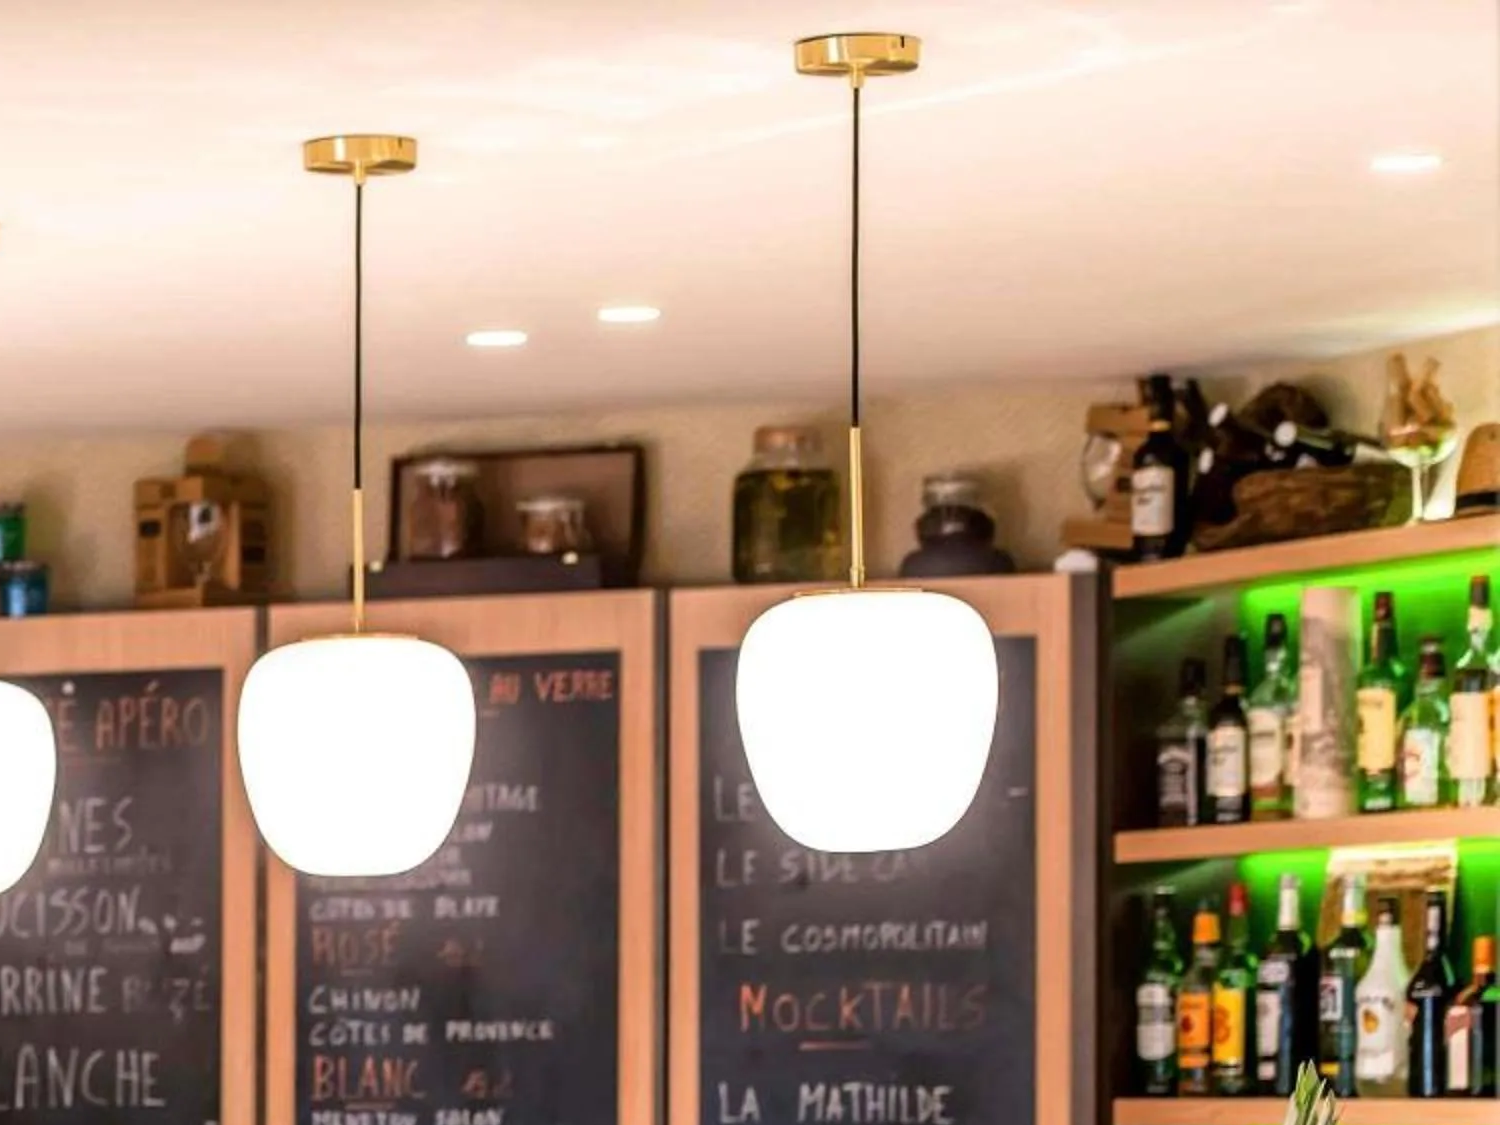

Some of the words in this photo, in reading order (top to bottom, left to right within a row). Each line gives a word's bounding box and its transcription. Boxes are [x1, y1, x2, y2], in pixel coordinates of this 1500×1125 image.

[533, 669, 613, 702] VERRE
[93, 679, 209, 751] APÉRO
[713, 774, 757, 823] LE
[715, 847, 759, 890] LE
[777, 846, 862, 886] SIDE
[311, 920, 400, 967] ROSÉ
[719, 916, 762, 956] LE
[779, 917, 989, 955] COSMOPOLITAIN
[308, 985, 421, 1015] CHINON
[739, 982, 990, 1034] MOCKTAILS
[403, 1020, 429, 1045] DE
[445, 1018, 554, 1042] PROVENCE
[312, 1055, 426, 1100] BLANC
[717, 1080, 761, 1125] LA
